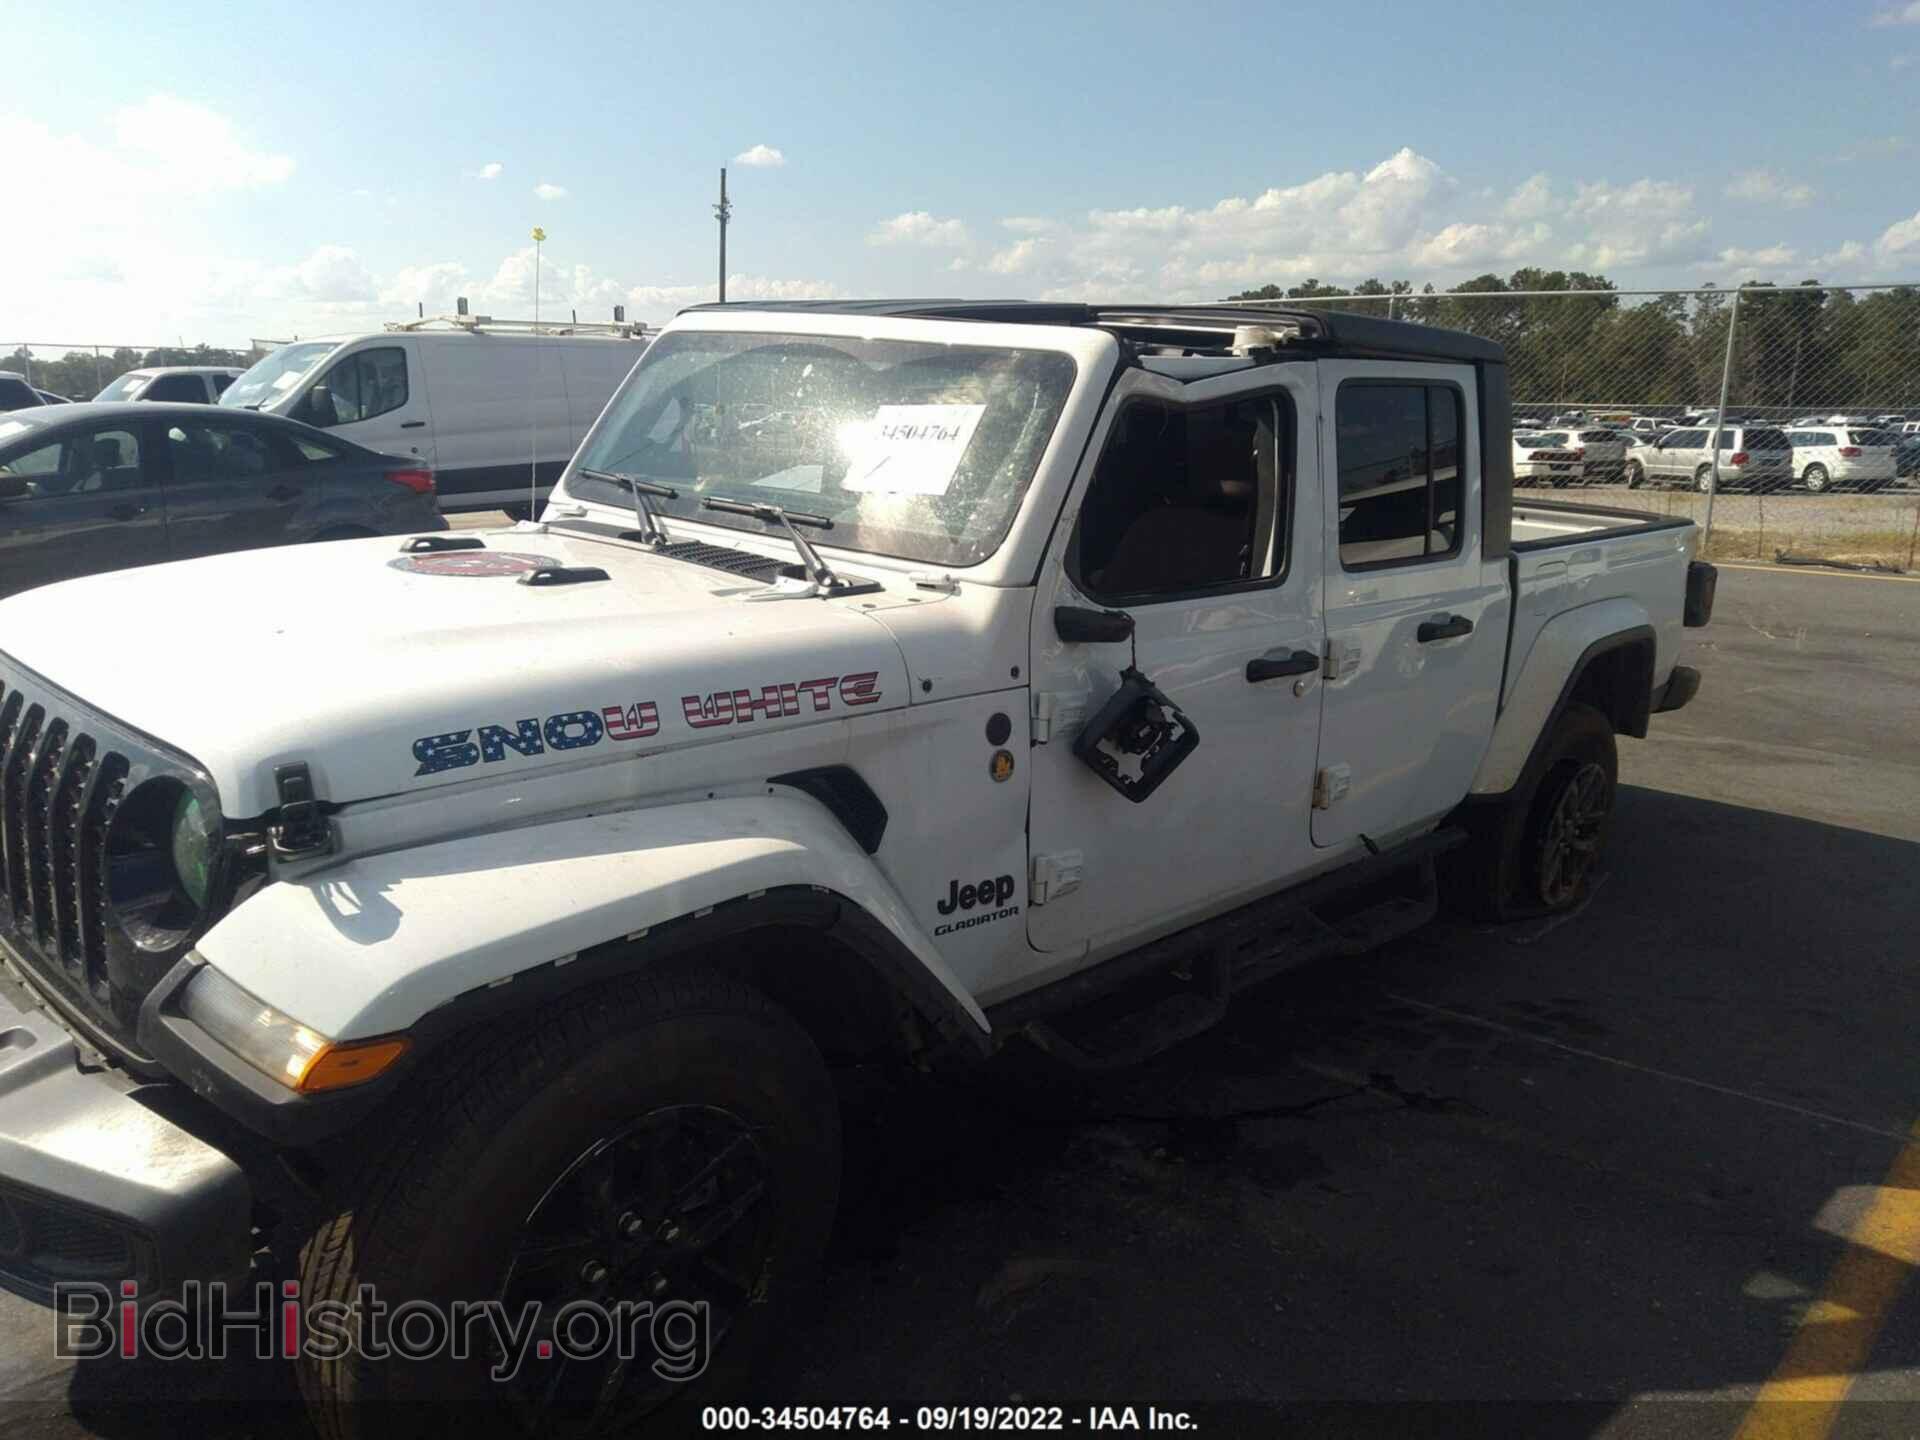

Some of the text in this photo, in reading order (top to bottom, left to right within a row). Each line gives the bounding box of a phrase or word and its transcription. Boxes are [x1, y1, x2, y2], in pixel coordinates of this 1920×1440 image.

[413, 671, 883, 776] SNOW WHITE
[937, 874, 1015, 915] Jeep
[934, 905, 1019, 936] GLADIATOR
